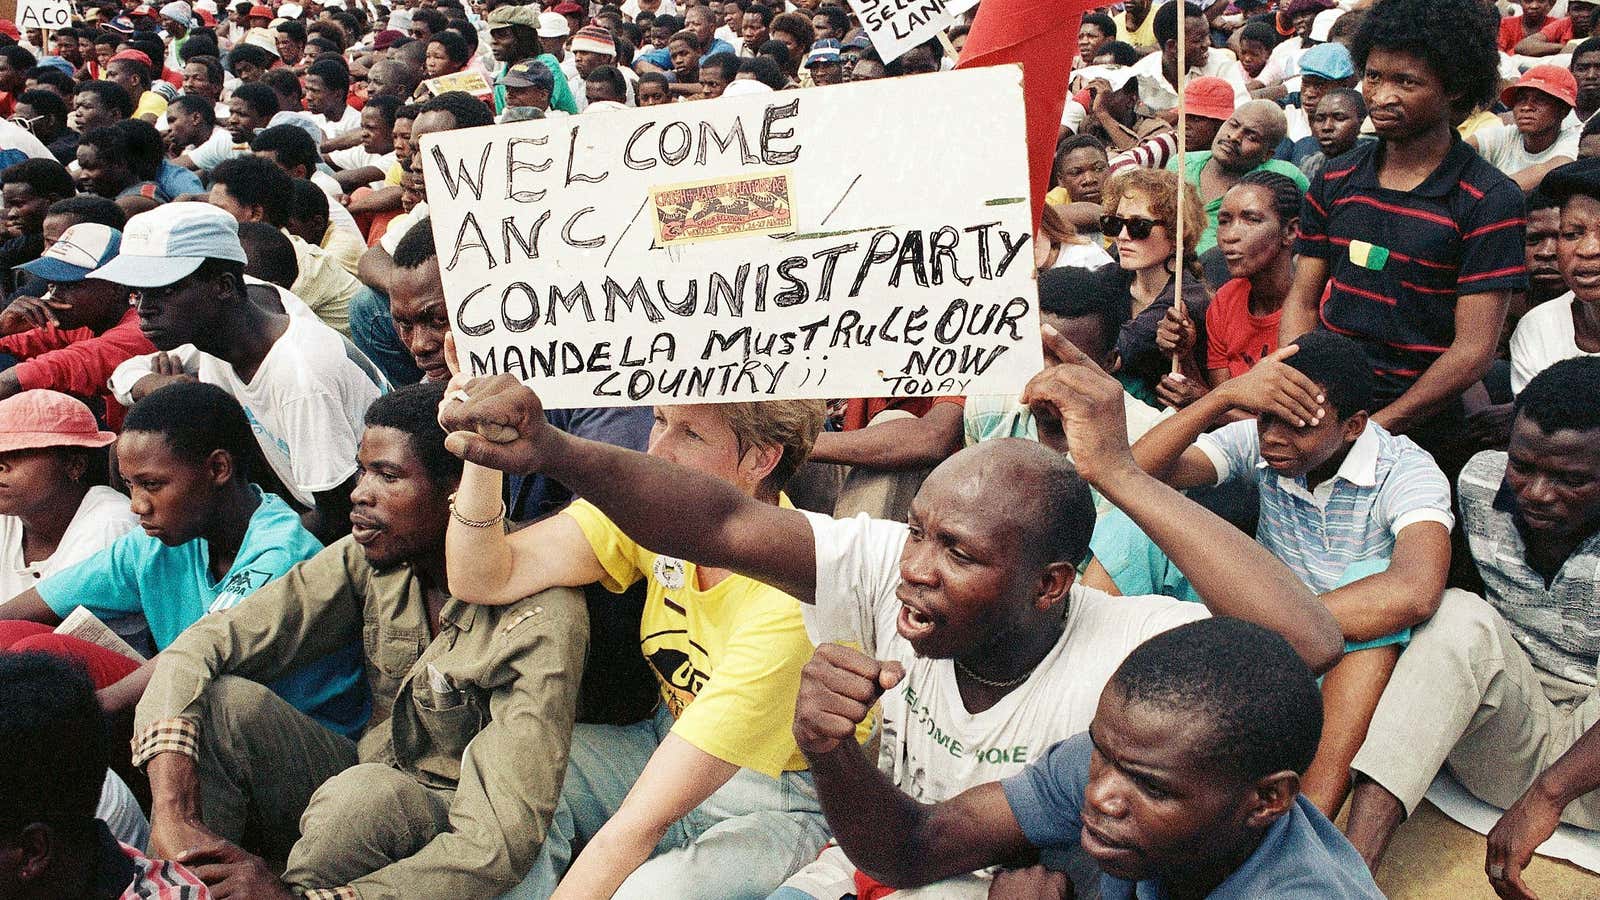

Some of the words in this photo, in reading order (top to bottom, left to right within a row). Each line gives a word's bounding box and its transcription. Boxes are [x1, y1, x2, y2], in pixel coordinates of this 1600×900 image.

[866, 0, 918, 31] SEL
[430, 98, 802, 203] WELCOME
[457, 243, 859, 337] COMMUNIST
[848, 221, 1031, 298] PARTY
[470, 332, 676, 381] MANDELA
[935, 297, 1030, 344] OUR
[900, 345, 1010, 376] NOW
[883, 376, 972, 396] TODAY
